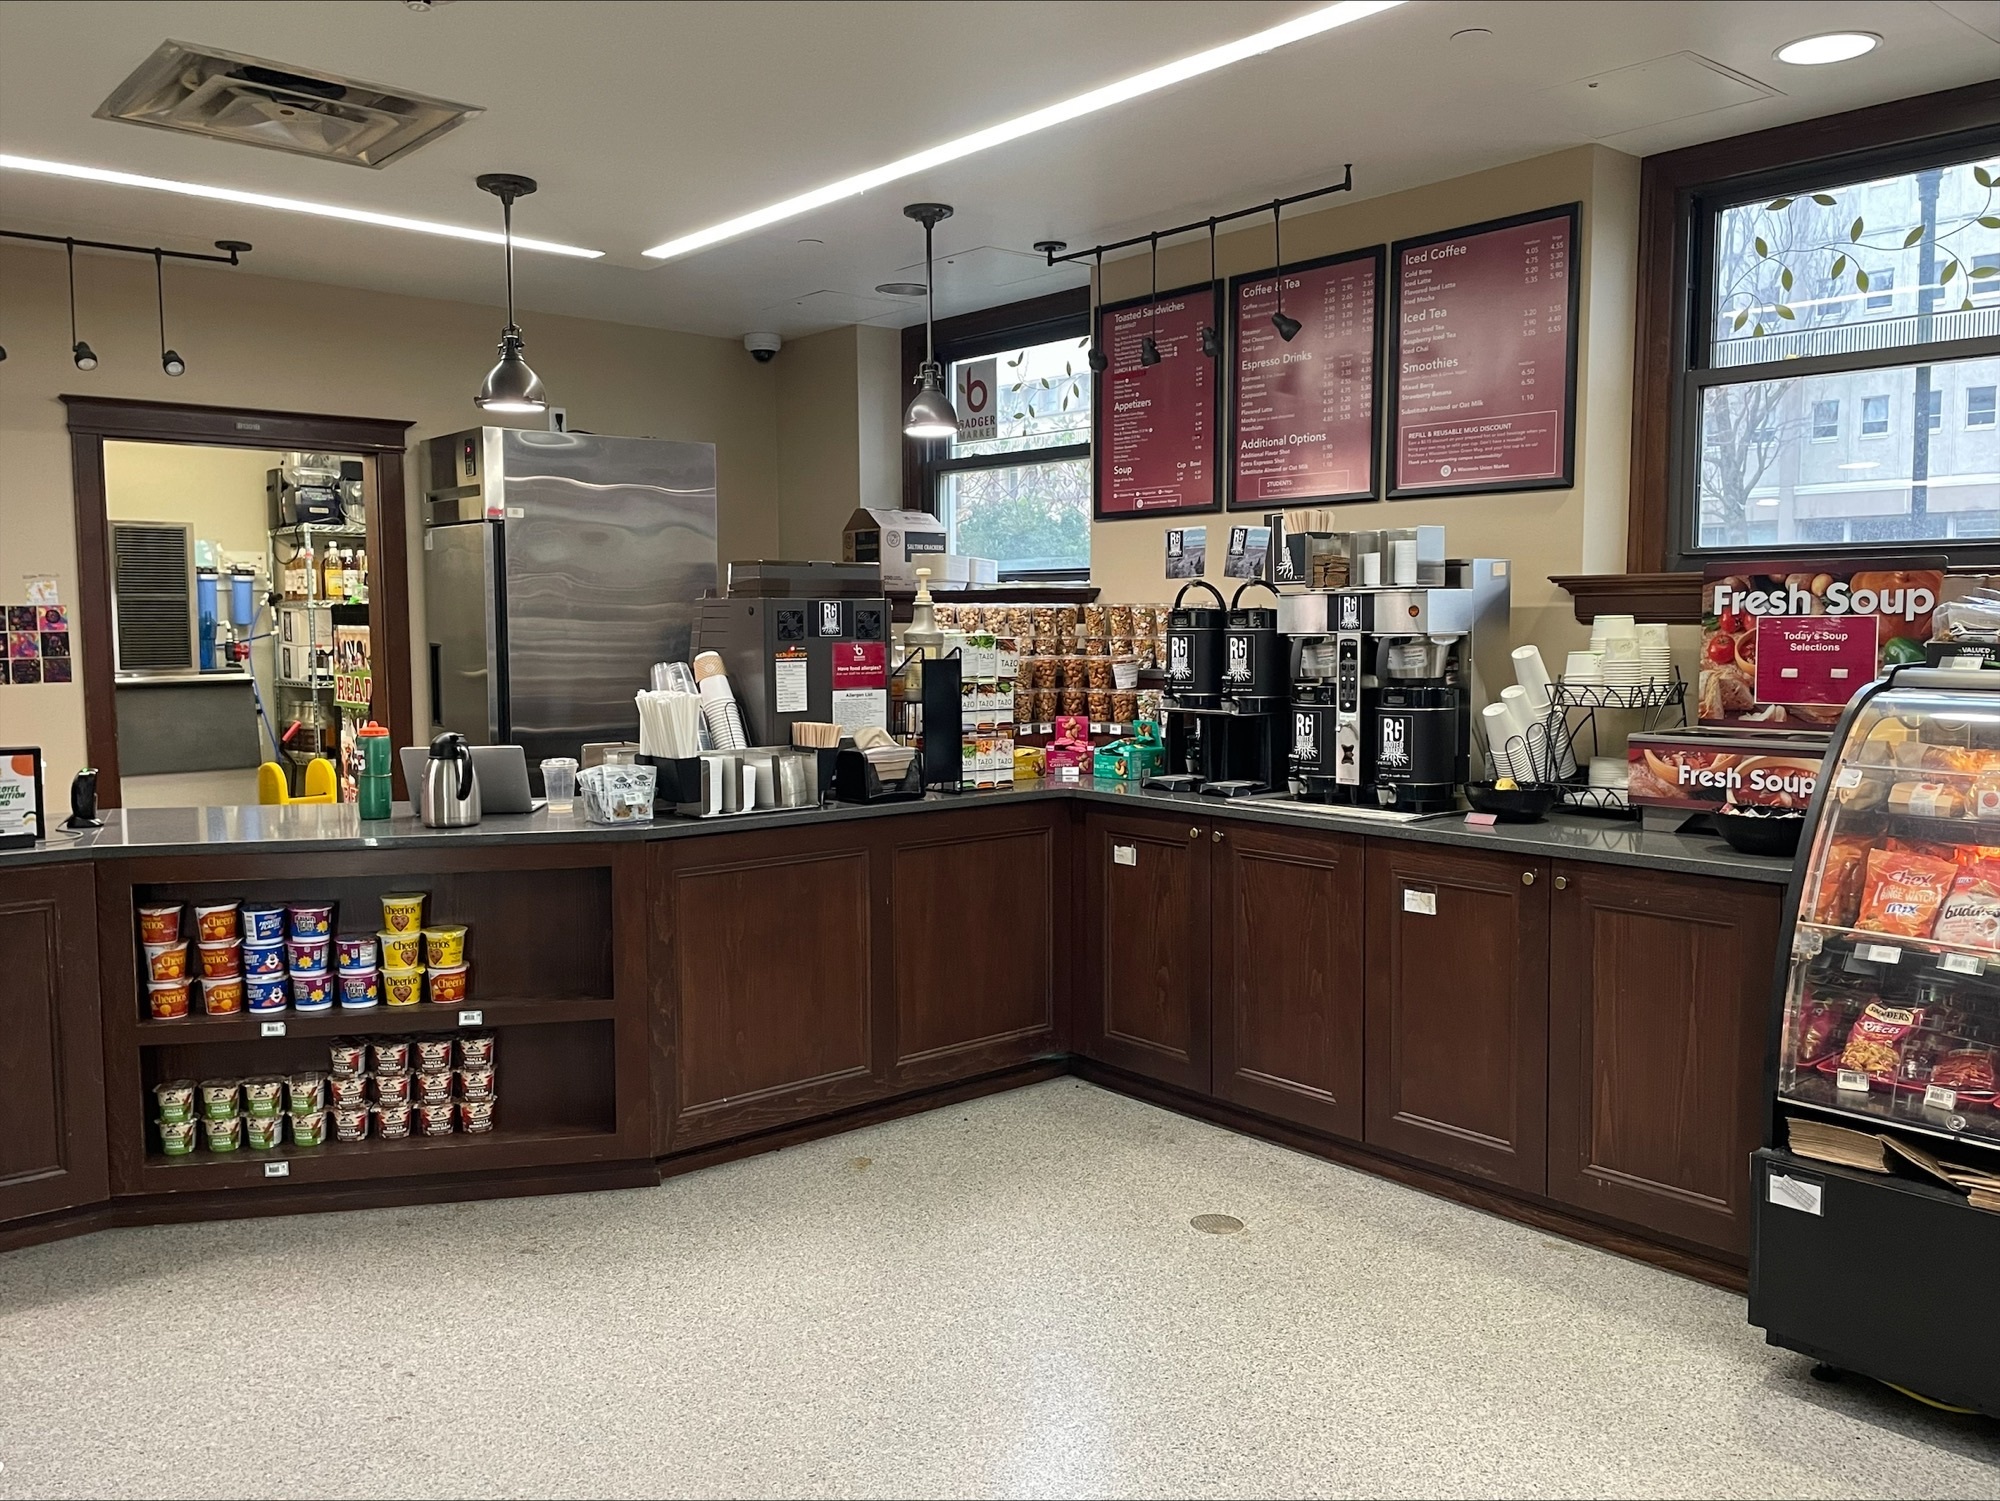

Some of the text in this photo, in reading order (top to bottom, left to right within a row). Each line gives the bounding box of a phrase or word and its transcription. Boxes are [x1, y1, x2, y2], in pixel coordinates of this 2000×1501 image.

[1406, 245, 1467, 265] Iced Coffee
[1243, 284, 1272, 298] Coffee
[1285, 279, 1300, 289] Tea
[1115, 309, 1141, 323] Toasted
[1404, 308, 1447, 323] Iced Tea
[1242, 358, 1280, 371] Espresso
[1283, 351, 1312, 363] Drinks
[1403, 357, 1458, 373] Smoothies
[1114, 399, 1152, 412] Appetizers
[1433, 428, 1462, 436] REUSABLE
[1480, 423, 1512, 431] DISCOUNT
[1241, 433, 1326, 450] Additional Options
[1114, 466, 1132, 475] Soup
[1344, 596, 1357, 612] RG
[1713, 581, 1935, 621] Fresh Soup
[1783, 631, 1848, 641] Today's Soup
[1172, 637, 1188, 657] RG
[1230, 637, 1247, 659] RG
[1790, 643, 1840, 651] Selections
[1296, 714, 1314, 736] RG
[1384, 718, 1404, 741] RG
[1678, 765, 1816, 798] Fresh Soup
[1888, 870, 1936, 887] Chex
[385, 905, 416, 914] Cheerios
[386, 976, 418, 986] Cheerios
[1864, 1021, 1900, 1034] PIECES
